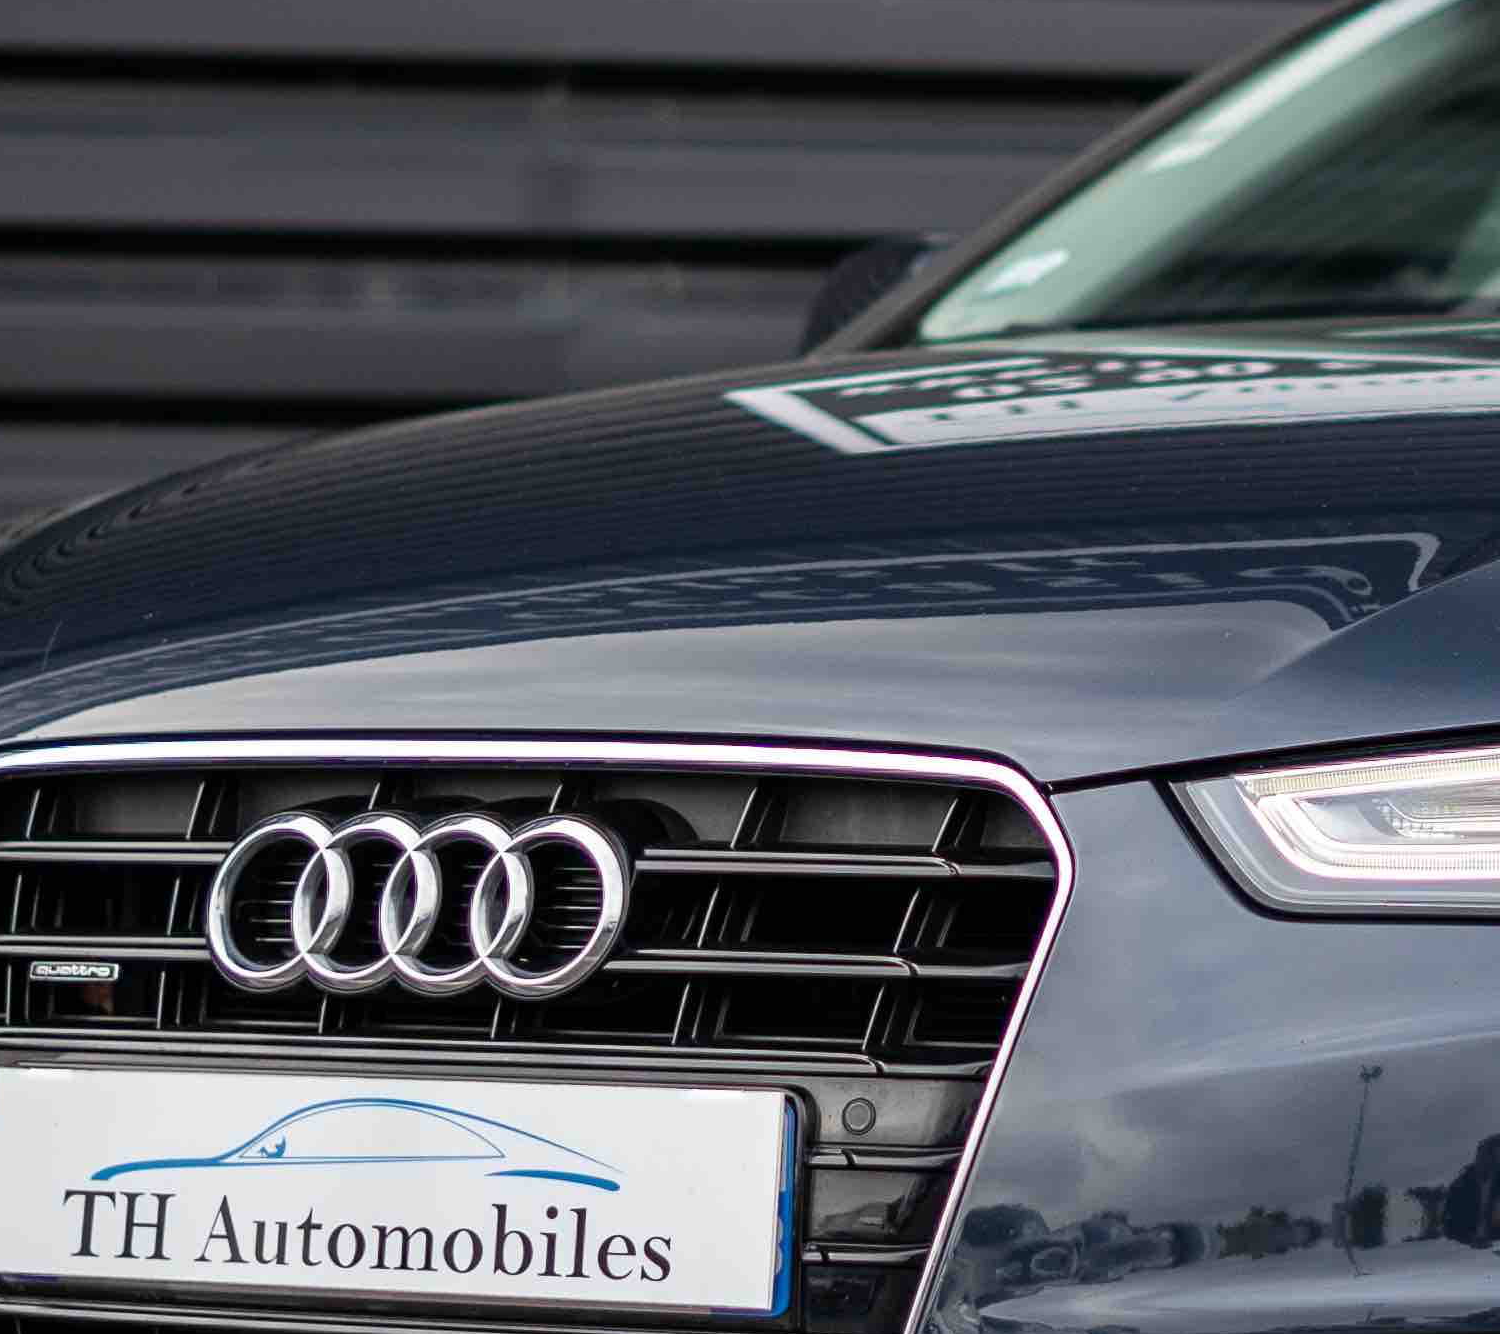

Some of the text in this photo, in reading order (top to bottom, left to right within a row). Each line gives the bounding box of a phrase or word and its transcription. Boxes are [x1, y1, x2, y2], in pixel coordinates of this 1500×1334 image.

[35, 964, 111, 977] quattro
[63, 1190, 672, 1282] TH Automobiles
